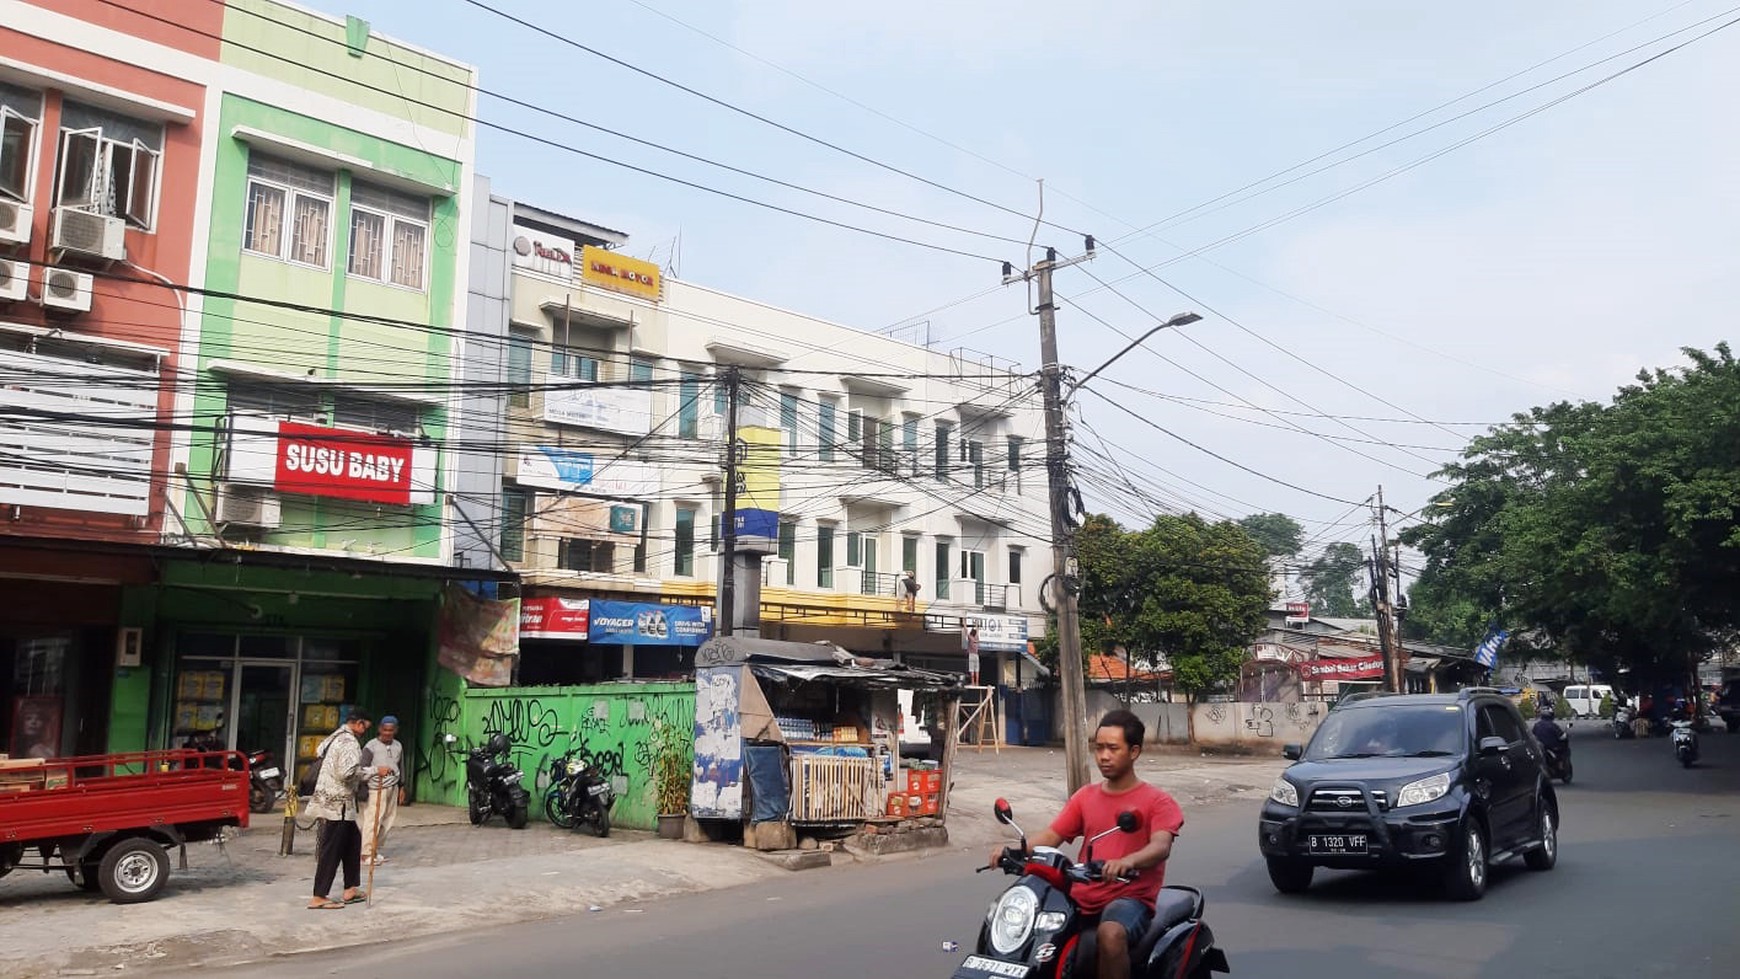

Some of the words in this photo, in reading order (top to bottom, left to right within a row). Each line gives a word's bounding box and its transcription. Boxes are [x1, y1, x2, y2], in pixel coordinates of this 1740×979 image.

[286, 444, 345, 476] SUSU
[348, 452, 405, 482] BABY
[593, 617, 635, 627] VOYAGER
[1311, 837, 1317, 847] B
[1323, 837, 1344, 847] 1320
[1349, 836, 1366, 847] VFF
